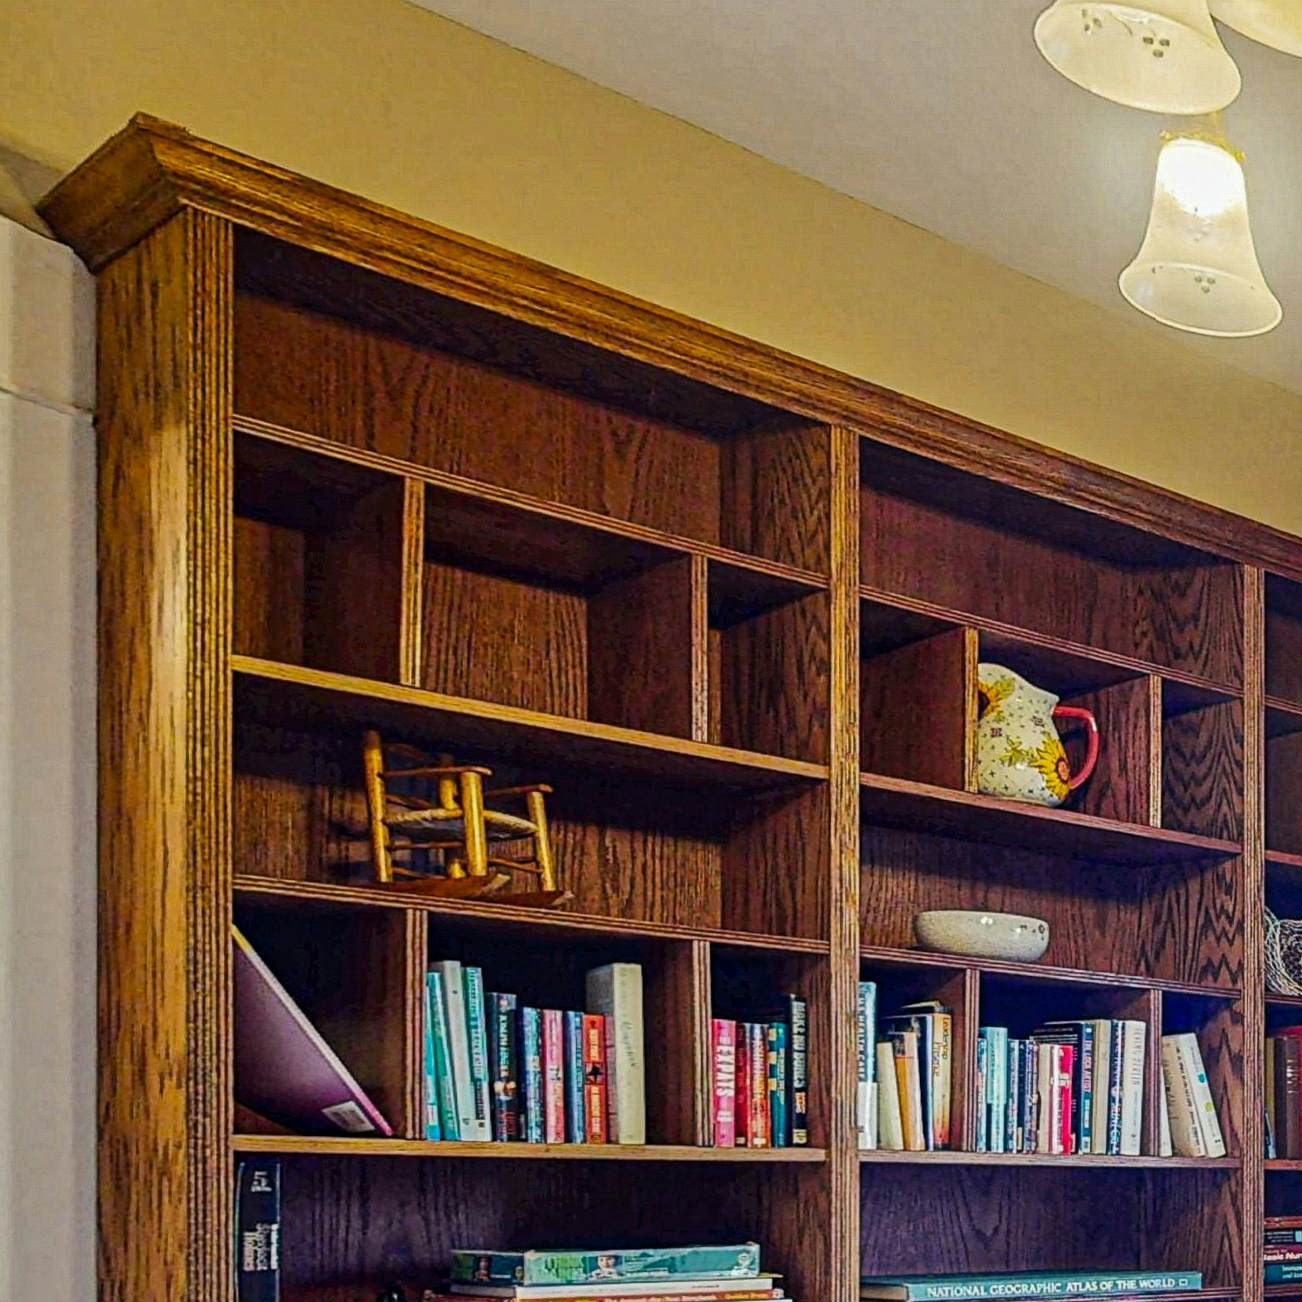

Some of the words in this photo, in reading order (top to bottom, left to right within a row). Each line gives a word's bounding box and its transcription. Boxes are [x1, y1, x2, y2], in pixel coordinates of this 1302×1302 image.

[792, 1001, 806, 1034] MAKE
[716, 1045, 735, 1097] EXPATS
[243, 1231, 258, 1271] Holmes
[256, 1223, 271, 1271] Sherlock
[927, 1286, 987, 1297] NATIONAL
[990, 1283, 1062, 1295] GEOGRAPHIC
[1066, 1281, 1098, 1292] ATLAS
[1099, 1280, 1114, 1291] OF
[1115, 1279, 1137, 1290] THE
[1138, 1278, 1175, 1289] WORLD
